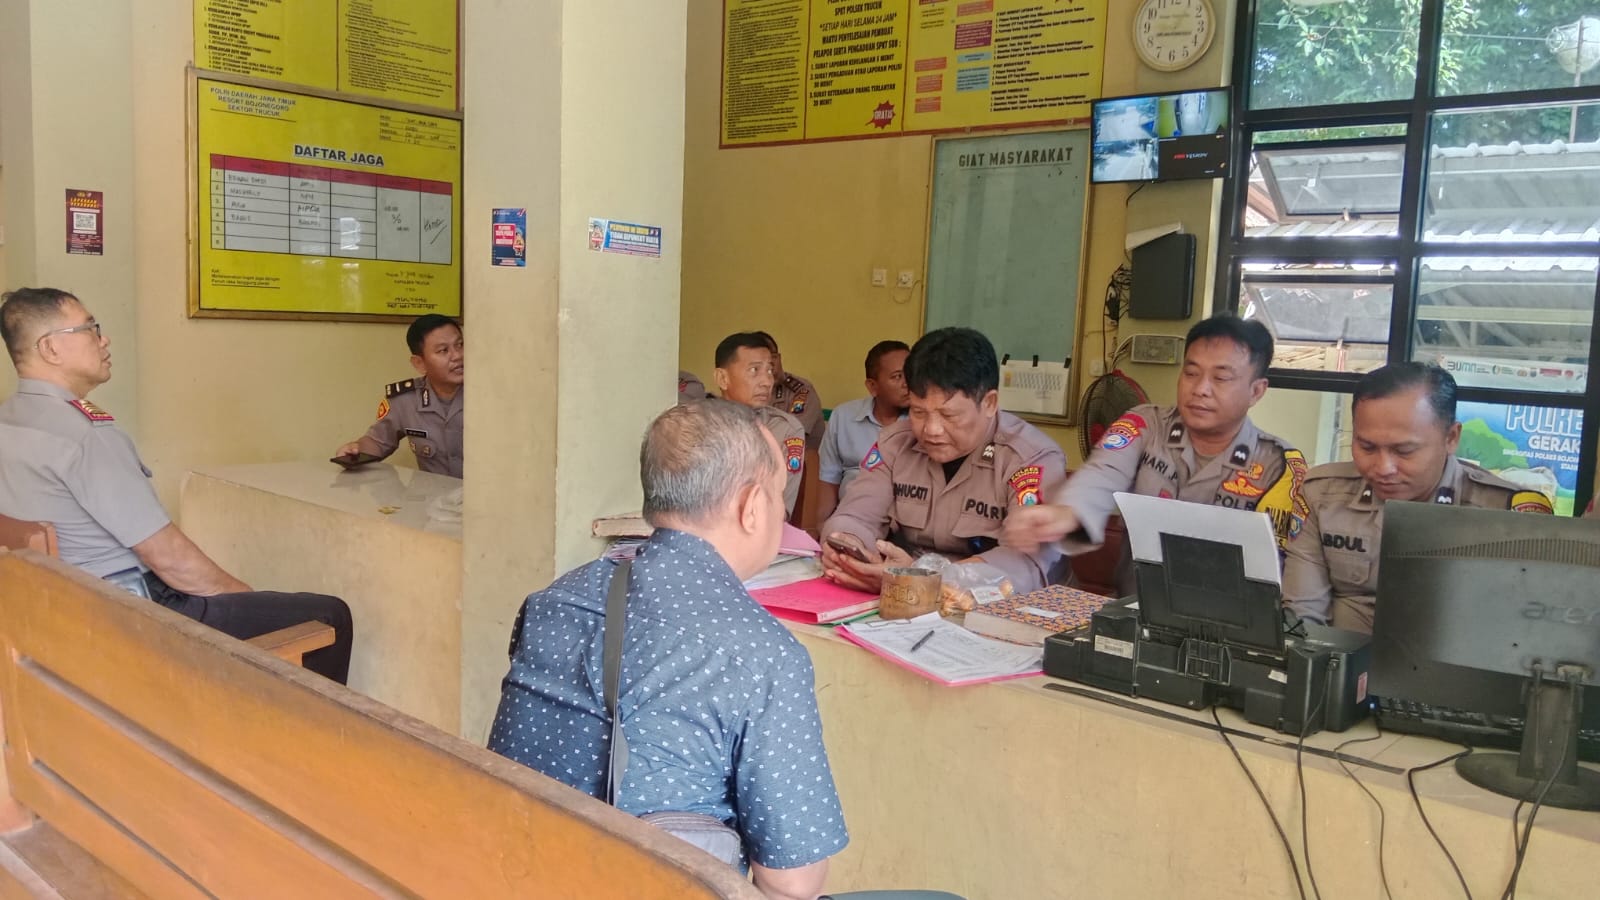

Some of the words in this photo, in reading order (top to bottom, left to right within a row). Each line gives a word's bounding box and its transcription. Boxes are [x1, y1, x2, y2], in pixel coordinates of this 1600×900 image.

[1148, 8, 1157, 20] 10
[1195, 6, 1202, 18] 2
[1144, 22, 1151, 33] 9
[1197, 20, 1204, 32] 3
[1147, 36, 1154, 48] 8
[1192, 34, 1198, 46] 4
[1156, 46, 1162, 58] 7
[1168, 49, 1176, 62] 6
[1182, 46, 1189, 57] 5
[231, 90, 257, 99] DAERAH
[245, 100, 289, 111] BOJONEGORO
[874, 109, 893, 119] GRATIS
[294, 144, 346, 161] DAFTAR
[350, 153, 384, 166] JAGA
[959, 153, 985, 167] GIAT
[989, 147, 1073, 166] MASYARAKAT
[1528, 435, 1581, 453] GERAK
[1142, 450, 1168, 474] HARI
[1322, 533, 1366, 552] BDUL
